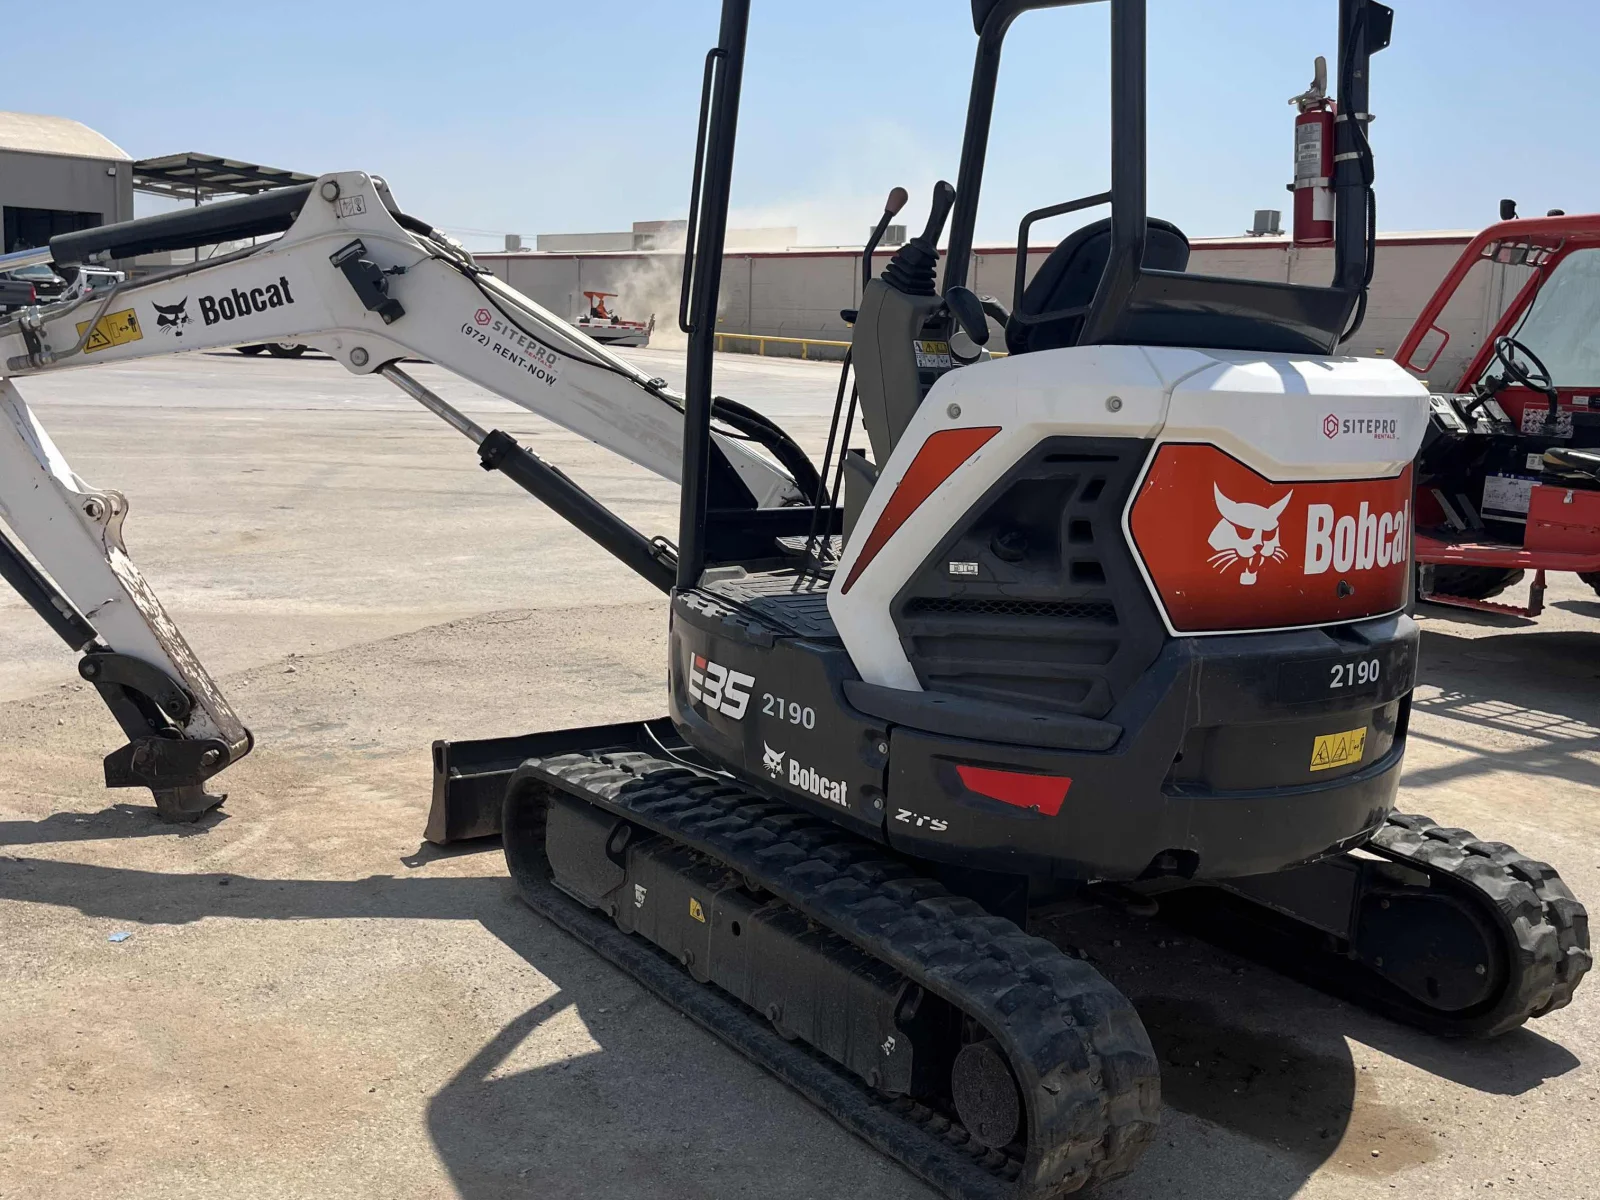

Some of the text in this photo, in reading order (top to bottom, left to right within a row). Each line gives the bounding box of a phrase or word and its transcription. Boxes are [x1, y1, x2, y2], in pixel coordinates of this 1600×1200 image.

[199, 276, 295, 326] Bobcat
[461, 322, 557, 386] (972) RENT-NOW
[492, 320, 558, 365] SITEPRO
[524, 349, 553, 369] RENTALS
[1342, 418, 1396, 434] SITEPRO
[1303, 499, 1409, 575] Bobcat
[688, 652, 756, 720] E35
[1329, 658, 1380, 689] 2190
[762, 692, 816, 730] 2190
[788, 758, 848, 808] Bobcat
